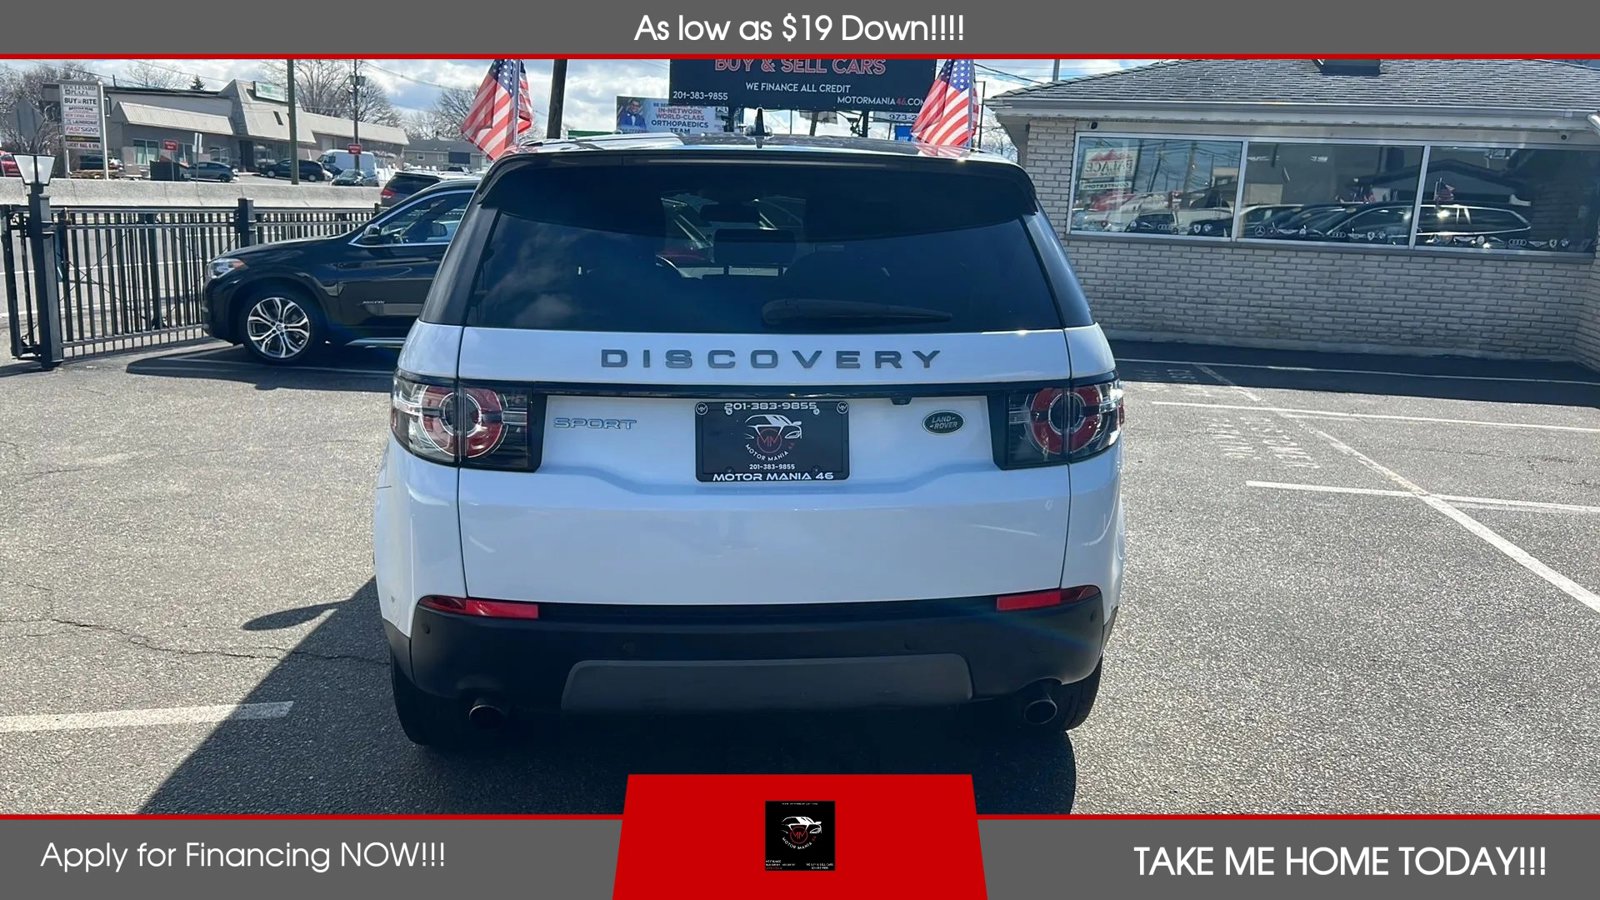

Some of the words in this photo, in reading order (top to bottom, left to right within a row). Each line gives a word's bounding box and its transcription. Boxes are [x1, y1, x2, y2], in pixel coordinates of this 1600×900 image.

[715, 59, 754, 72] BUY
[761, 59, 775, 73] &
[781, 59, 828, 74] SELL
[832, 59, 886, 75] CARS
[745, 82, 759, 91] WE
[760, 82, 799, 92] FINANCE
[800, 84, 817, 93] ALL
[819, 84, 851, 94] CREDIT
[673, 90, 729, 101] 201-383-9855
[657, 107, 703, 115] IN-NETWORK
[656, 113, 705, 121] WORLD-CLASS
[651, 119, 709, 128] ORTHOPAEDICS
[600, 348, 941, 370] DISCOVERY
[724, 402, 818, 411] 201-383-9855
[553, 417, 638, 430] SPORT
[712, 473, 763, 482] MOTOR
[766, 472, 812, 481] MANIA
[815, 472, 835, 480] 46
